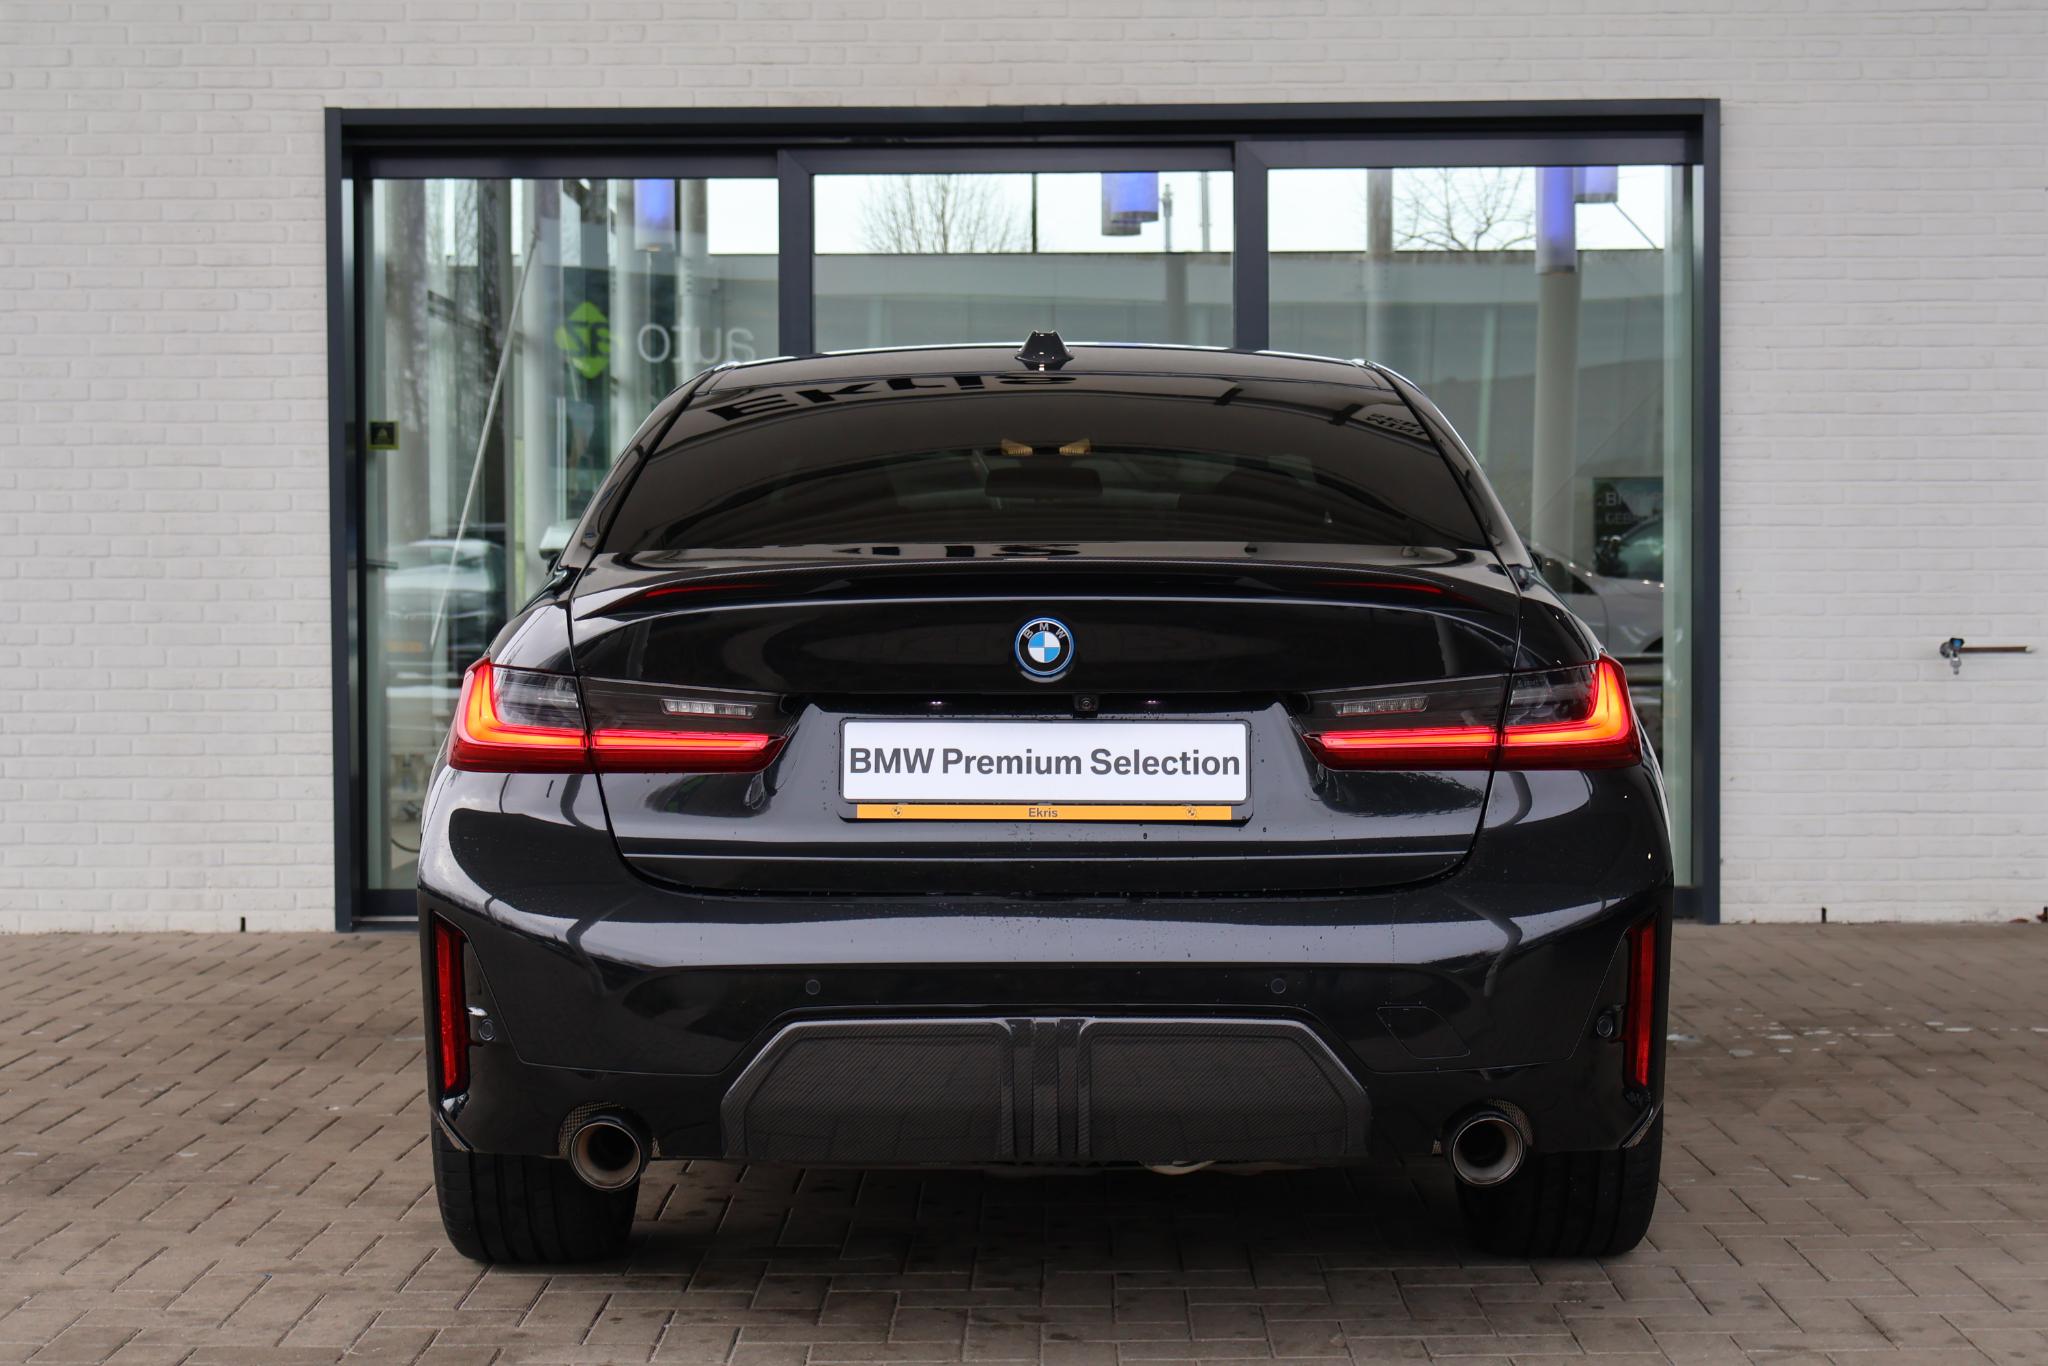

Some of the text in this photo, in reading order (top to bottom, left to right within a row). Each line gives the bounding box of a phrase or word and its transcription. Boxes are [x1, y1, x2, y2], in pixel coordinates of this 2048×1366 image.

[1023, 622, 1067, 640] BMW
[850, 747, 1240, 776] BMW Premium Selection
[1028, 807, 1059, 818] Ekris
